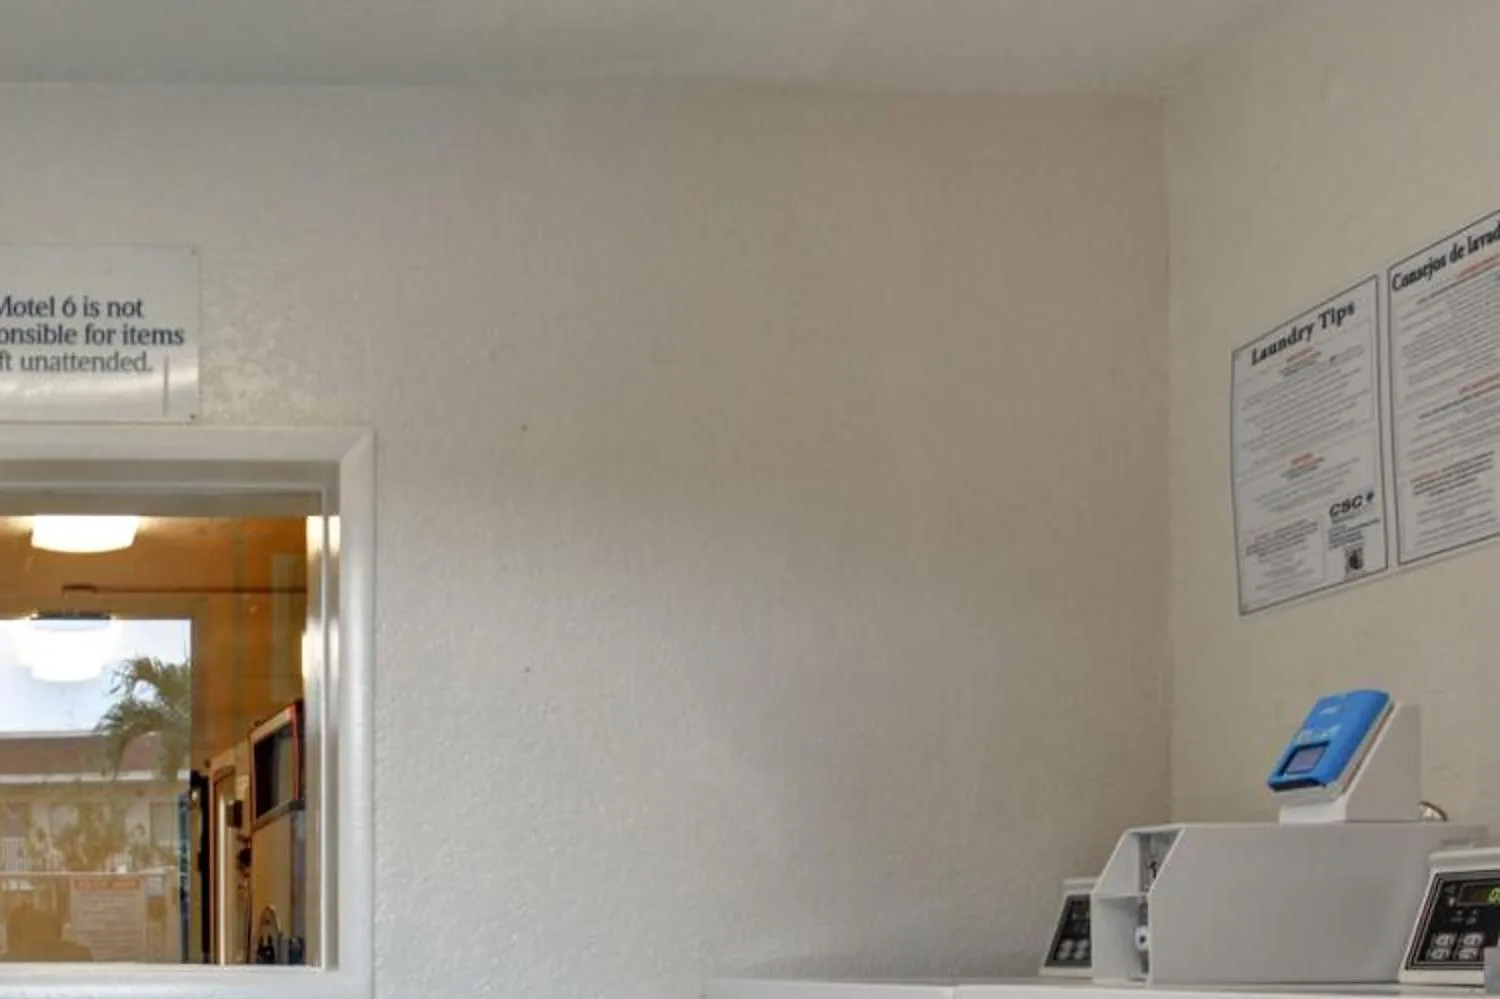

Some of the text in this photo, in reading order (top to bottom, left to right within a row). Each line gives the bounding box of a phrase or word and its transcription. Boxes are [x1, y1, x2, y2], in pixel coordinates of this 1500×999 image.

[1392, 255, 1447, 292] Consejos
[1449, 242, 1465, 263] de
[61, 296, 77, 318] 6
[83, 295, 100, 318] is
[106, 298, 144, 318] not
[85, 323, 116, 345] for
[122, 323, 185, 346] items
[1251, 300, 1355, 366] Laundry Tips
[20, 350, 153, 373] unattended.
[1329, 495, 1362, 518] CSC
